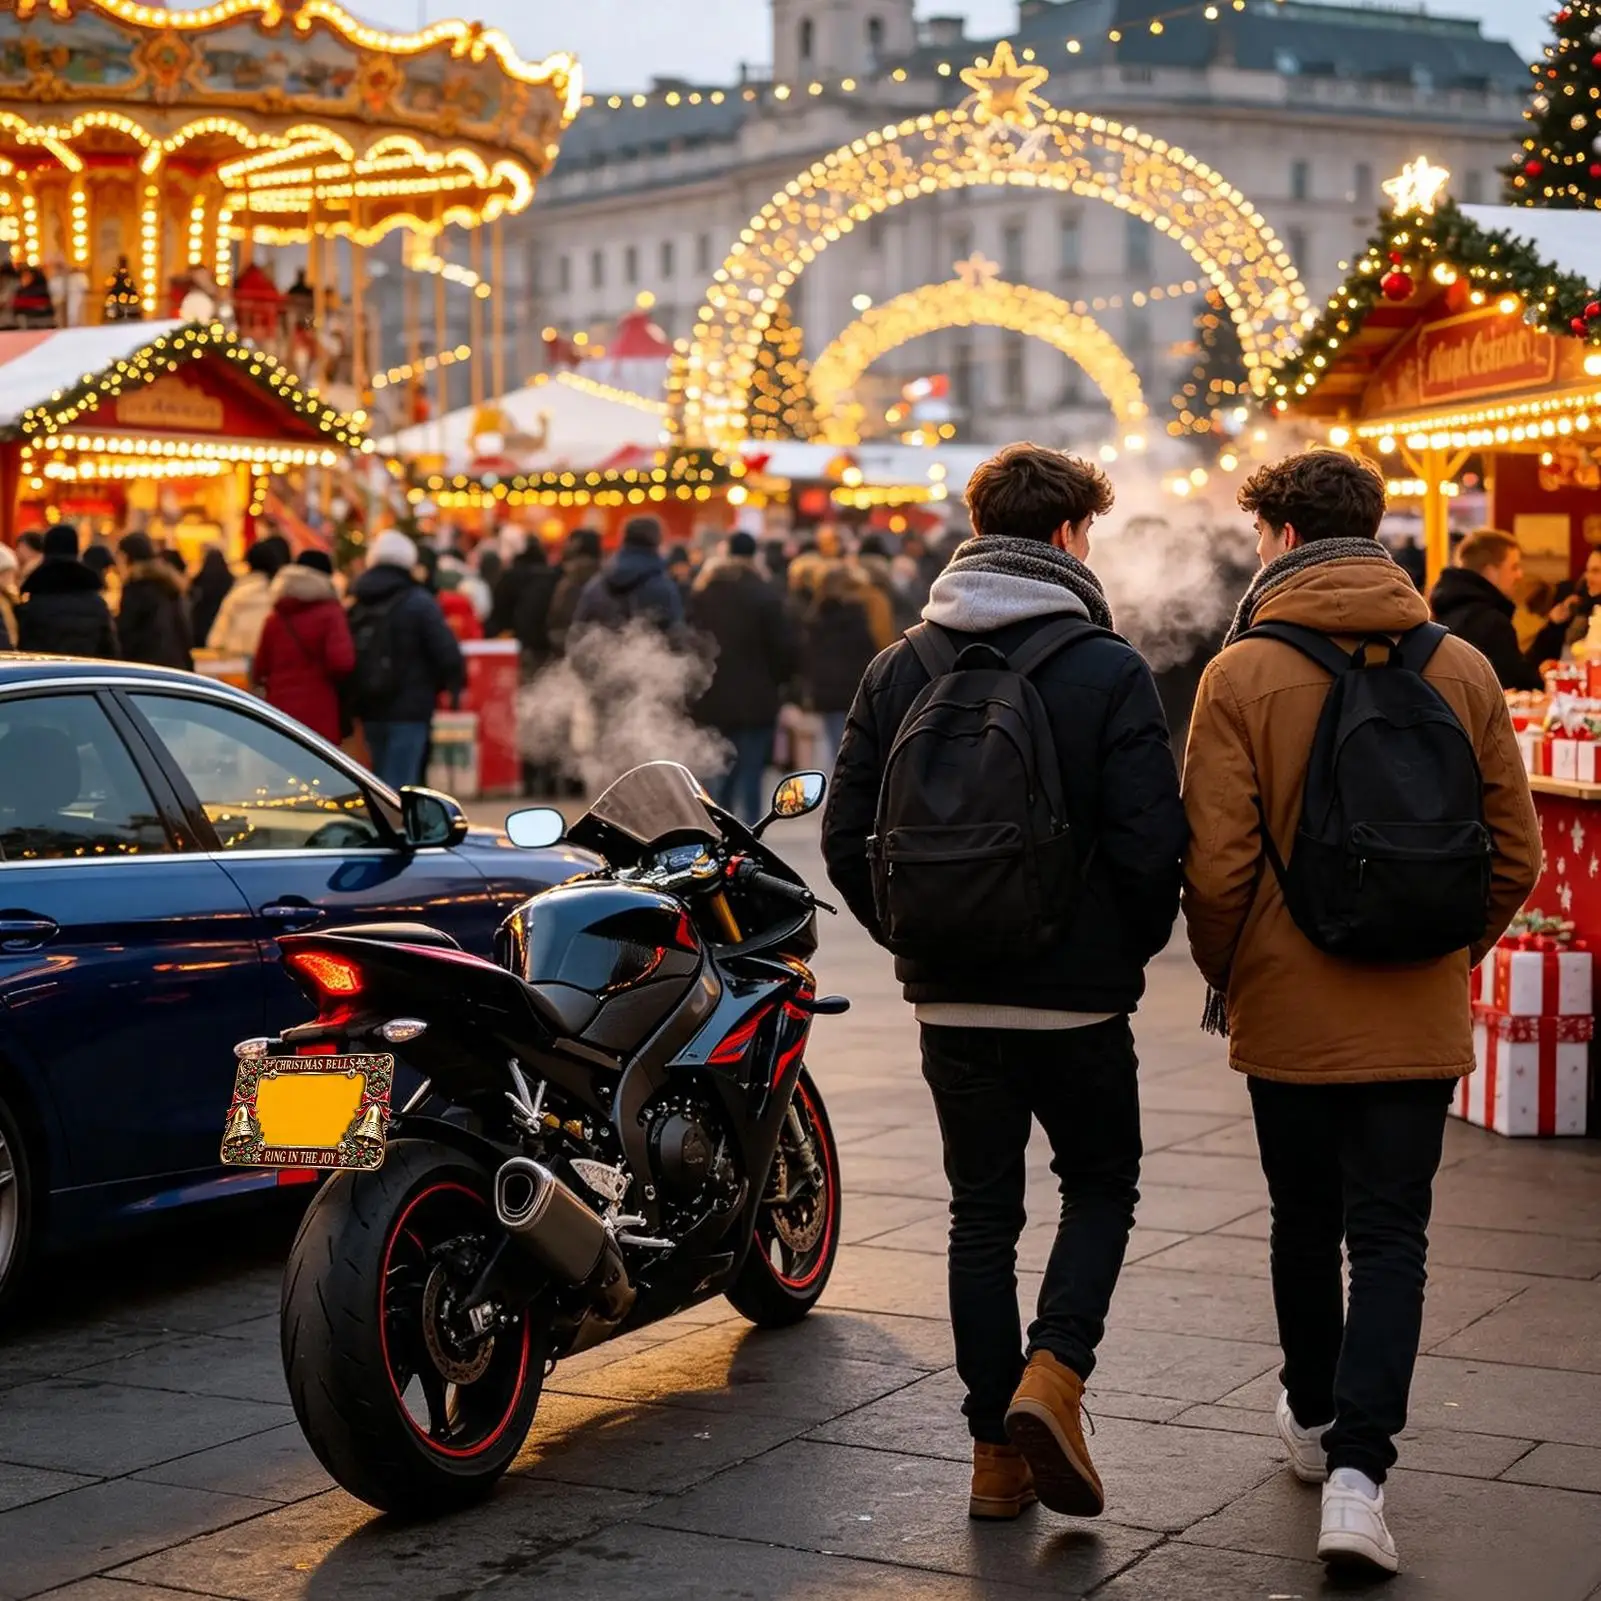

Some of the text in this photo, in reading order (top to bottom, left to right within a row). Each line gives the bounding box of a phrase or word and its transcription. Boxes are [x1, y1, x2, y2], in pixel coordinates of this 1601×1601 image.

[275, 1058, 354, 1071] CHRISTMAS BELLS
[264, 1151, 336, 1164] RING IN THE JOY
